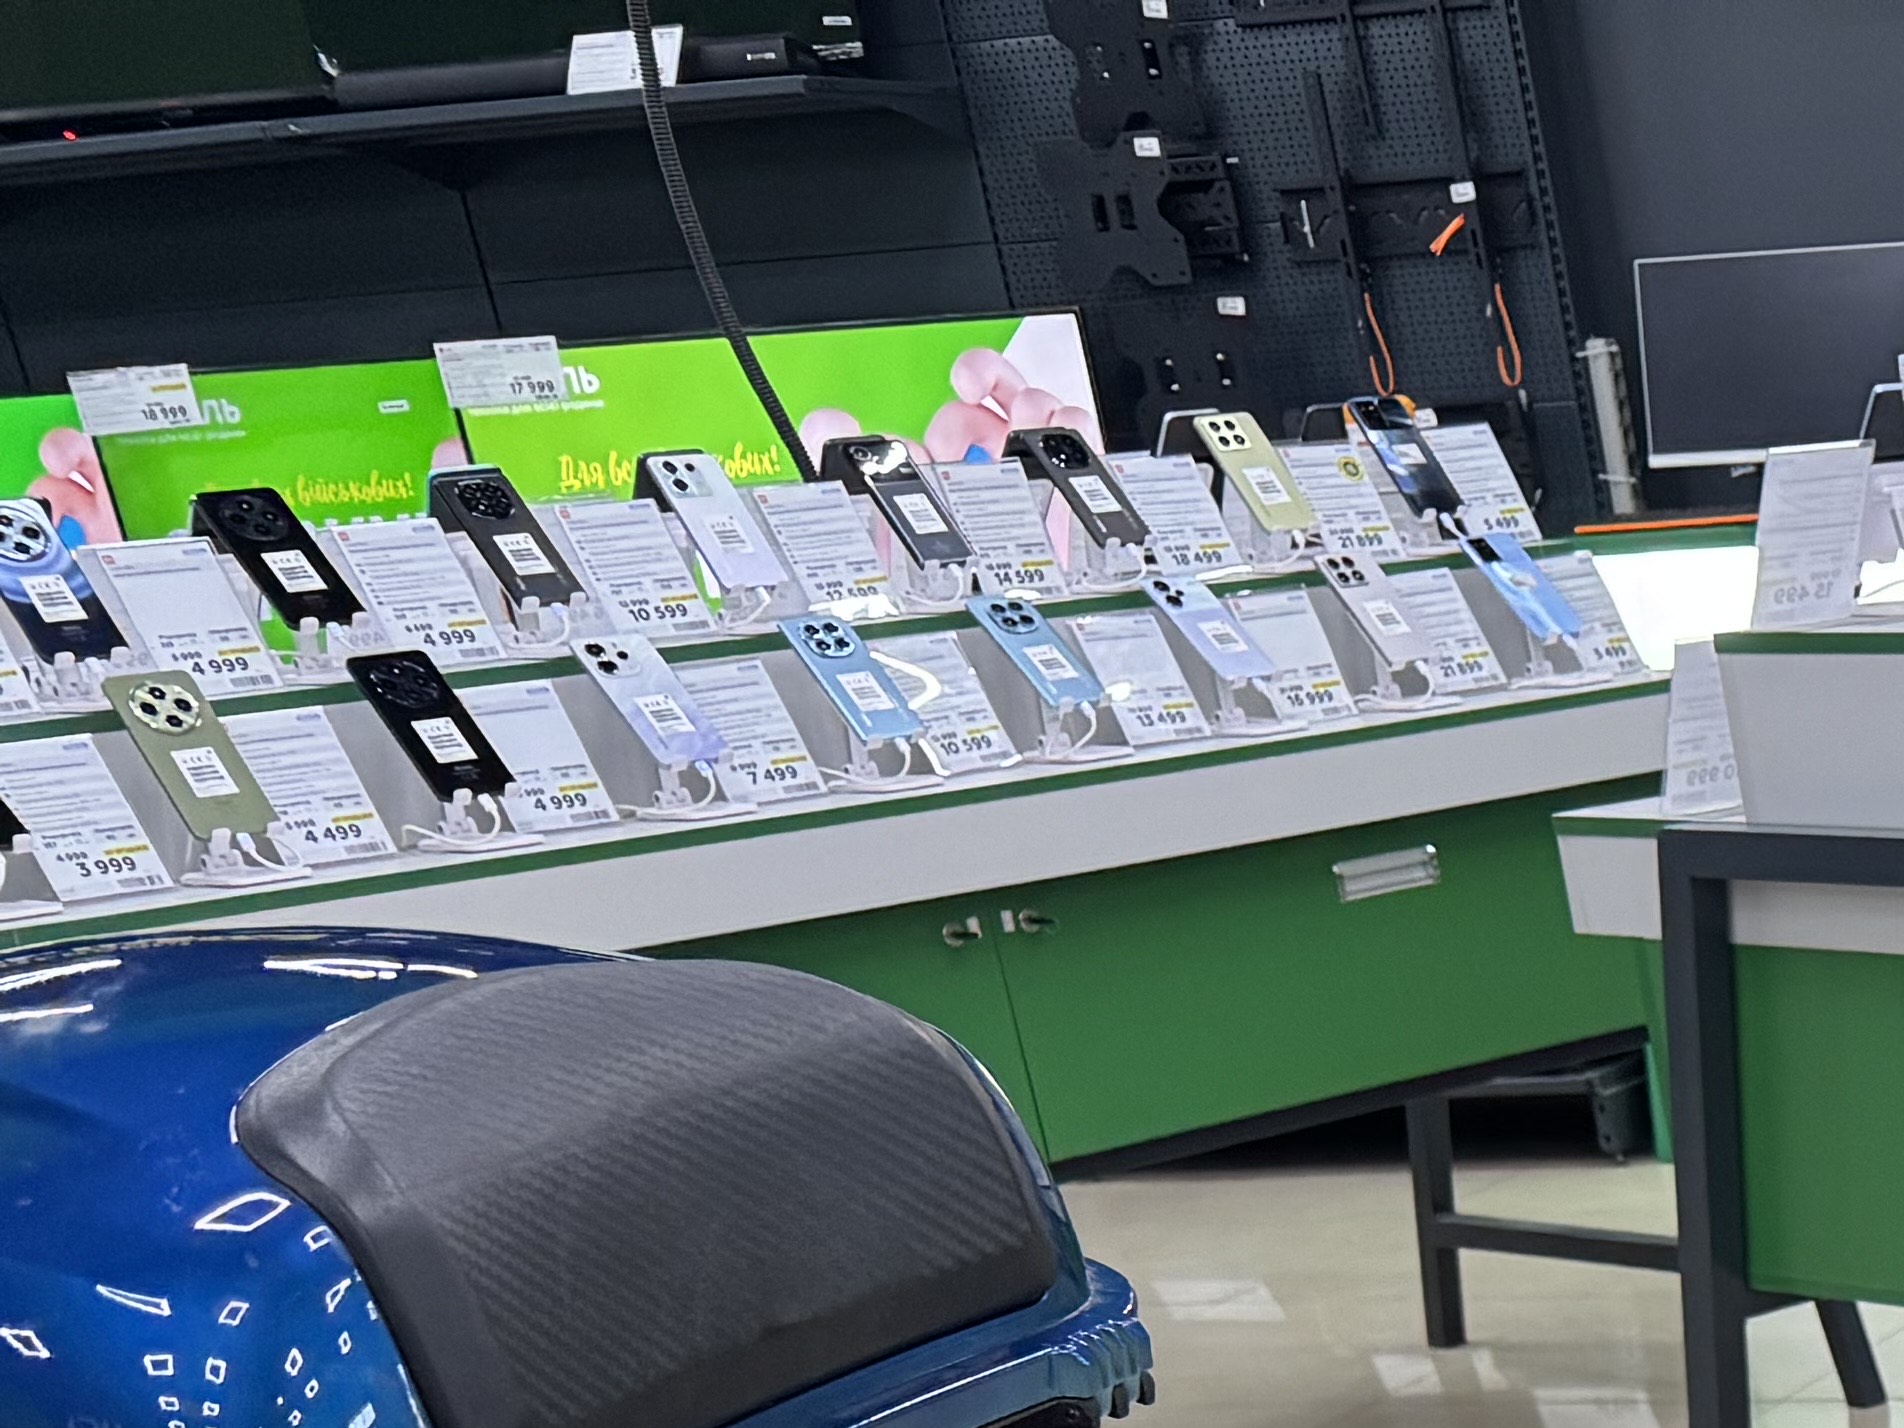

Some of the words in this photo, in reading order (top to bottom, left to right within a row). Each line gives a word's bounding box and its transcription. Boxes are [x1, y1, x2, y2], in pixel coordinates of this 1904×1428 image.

[559, 454, 605, 493] Для
[627, 606, 651, 623] 10
[653, 602, 689, 621] 599
[423, 632, 437, 647] 4
[439, 628, 477, 646] 999
[191, 660, 206, 676] 4
[208, 655, 249, 674] 999
[745, 770, 758, 785] 7
[763, 764, 798, 782] 499
[534, 797, 547, 811] 4
[549, 792, 588, 810] 999
[303, 829, 319, 844] 4
[323, 822, 363, 842] 499
[75, 861, 92, 878] 3
[94, 855, 137, 875] 999
